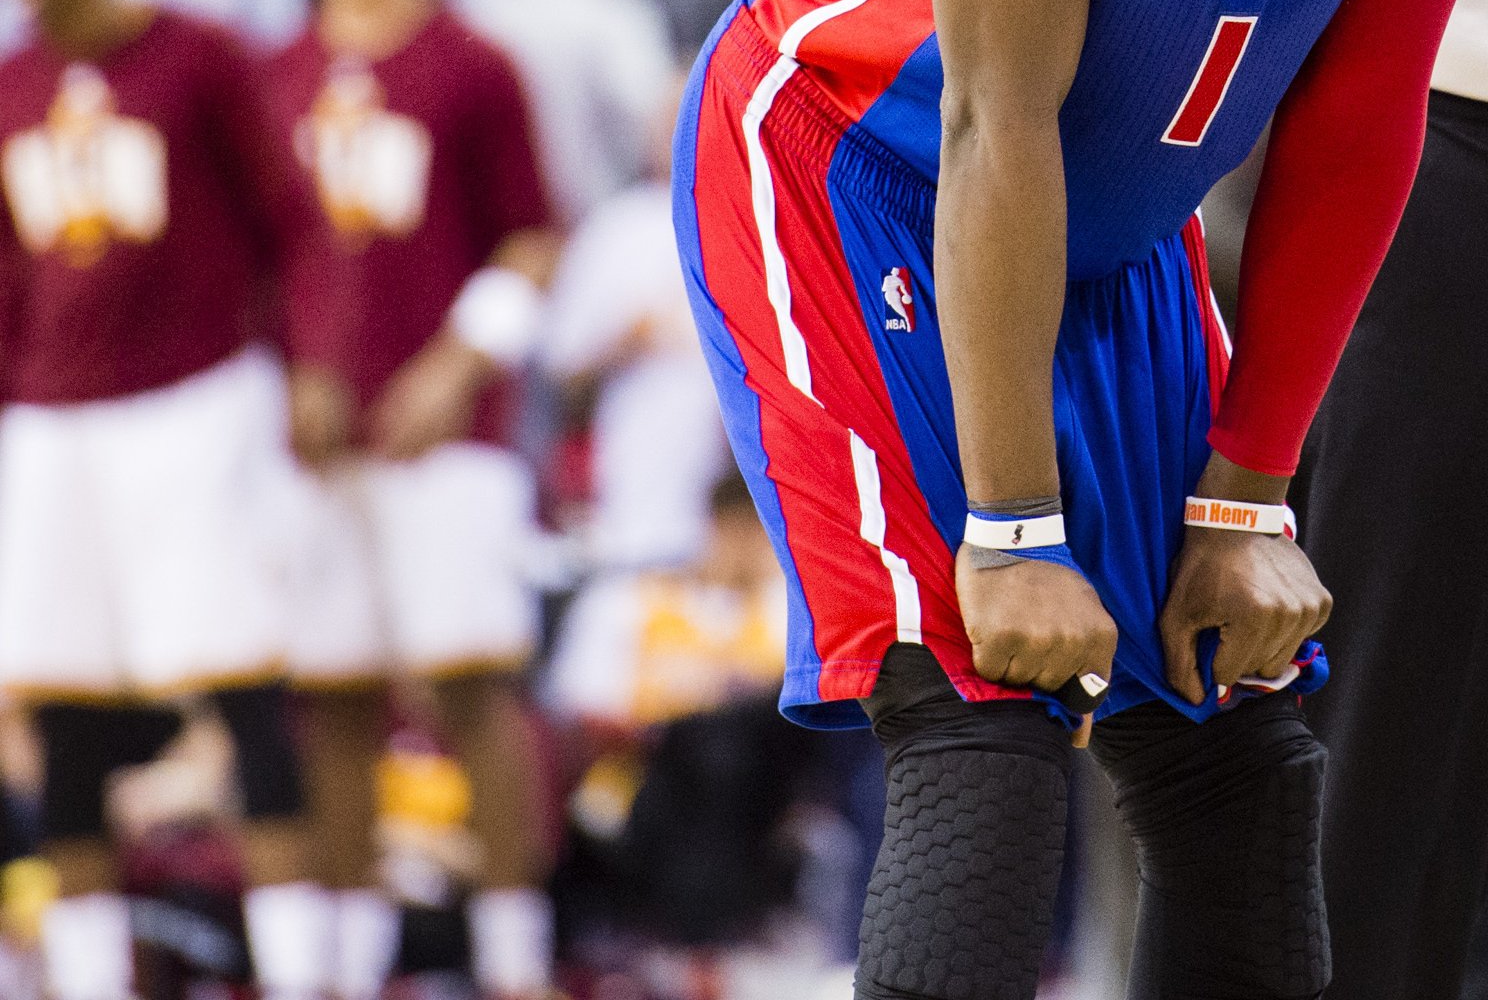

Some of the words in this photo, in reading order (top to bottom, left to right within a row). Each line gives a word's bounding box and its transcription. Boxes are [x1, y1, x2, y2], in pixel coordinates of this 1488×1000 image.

[1160, 15, 1259, 147] 1
[885, 319, 906, 330] NBA
[1209, 502, 1258, 529] Henry
